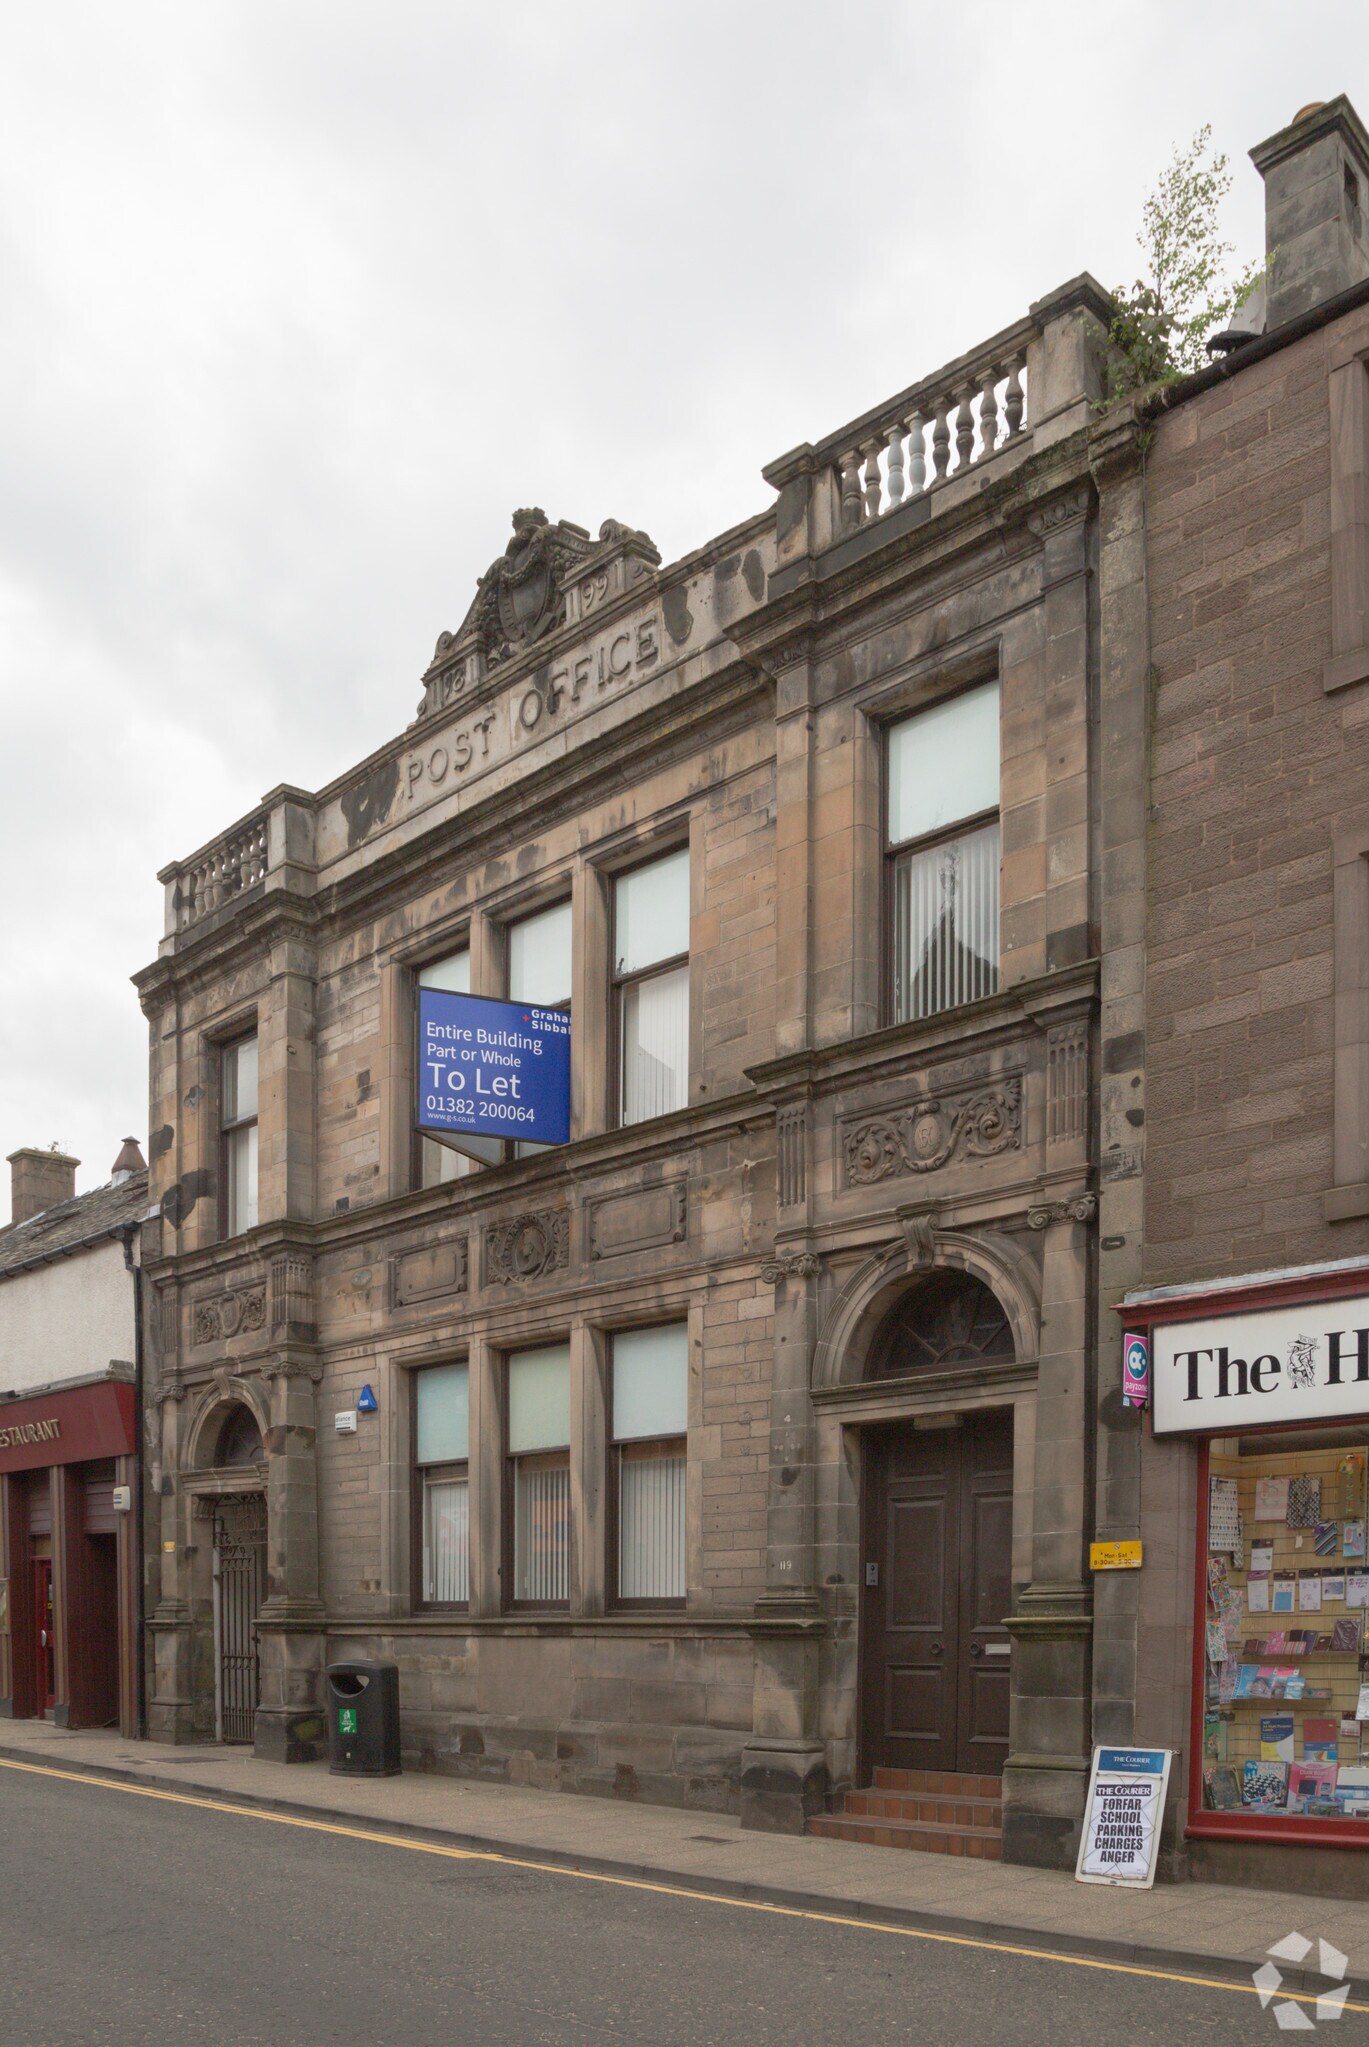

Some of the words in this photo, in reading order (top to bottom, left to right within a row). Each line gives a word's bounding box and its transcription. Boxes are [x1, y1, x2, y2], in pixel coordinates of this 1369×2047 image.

[583, 574, 608, 610] 99
[406, 711, 496, 799] POST
[519, 615, 660, 731] OFFICE
[531, 1009, 571, 1024] Graha
[427, 1022, 472, 1041] Entire
[477, 1028, 543, 1055] Building
[427, 1043, 456, 1059] Part
[461, 1050, 477, 1061] or
[481, 1050, 521, 1067] Whole
[427, 1062, 466, 1091] To
[476, 1068, 521, 1099] Let
[426, 1095, 475, 1115] 01382
[479, 1101, 535, 1122] 200064
[427, 1113, 476, 1123] www.g-s.co.uk
[1173, 1346, 1282, 1402] The
[1323, 1328, 1369, 1386] H
[1125, 1382, 1148, 1393] payzone
[1097, 1787, 1114, 1795] THE
[1114, 1785, 1151, 1796] COURIER
[1103, 1798, 1142, 1811] FORFAR
[1100, 1811, 1142, 1824] SCHOOL
[1096, 1824, 1143, 1837] PARKING
[1094, 1837, 1144, 1851] CHARGES
[1100, 1851, 1135, 1863] ANGER
